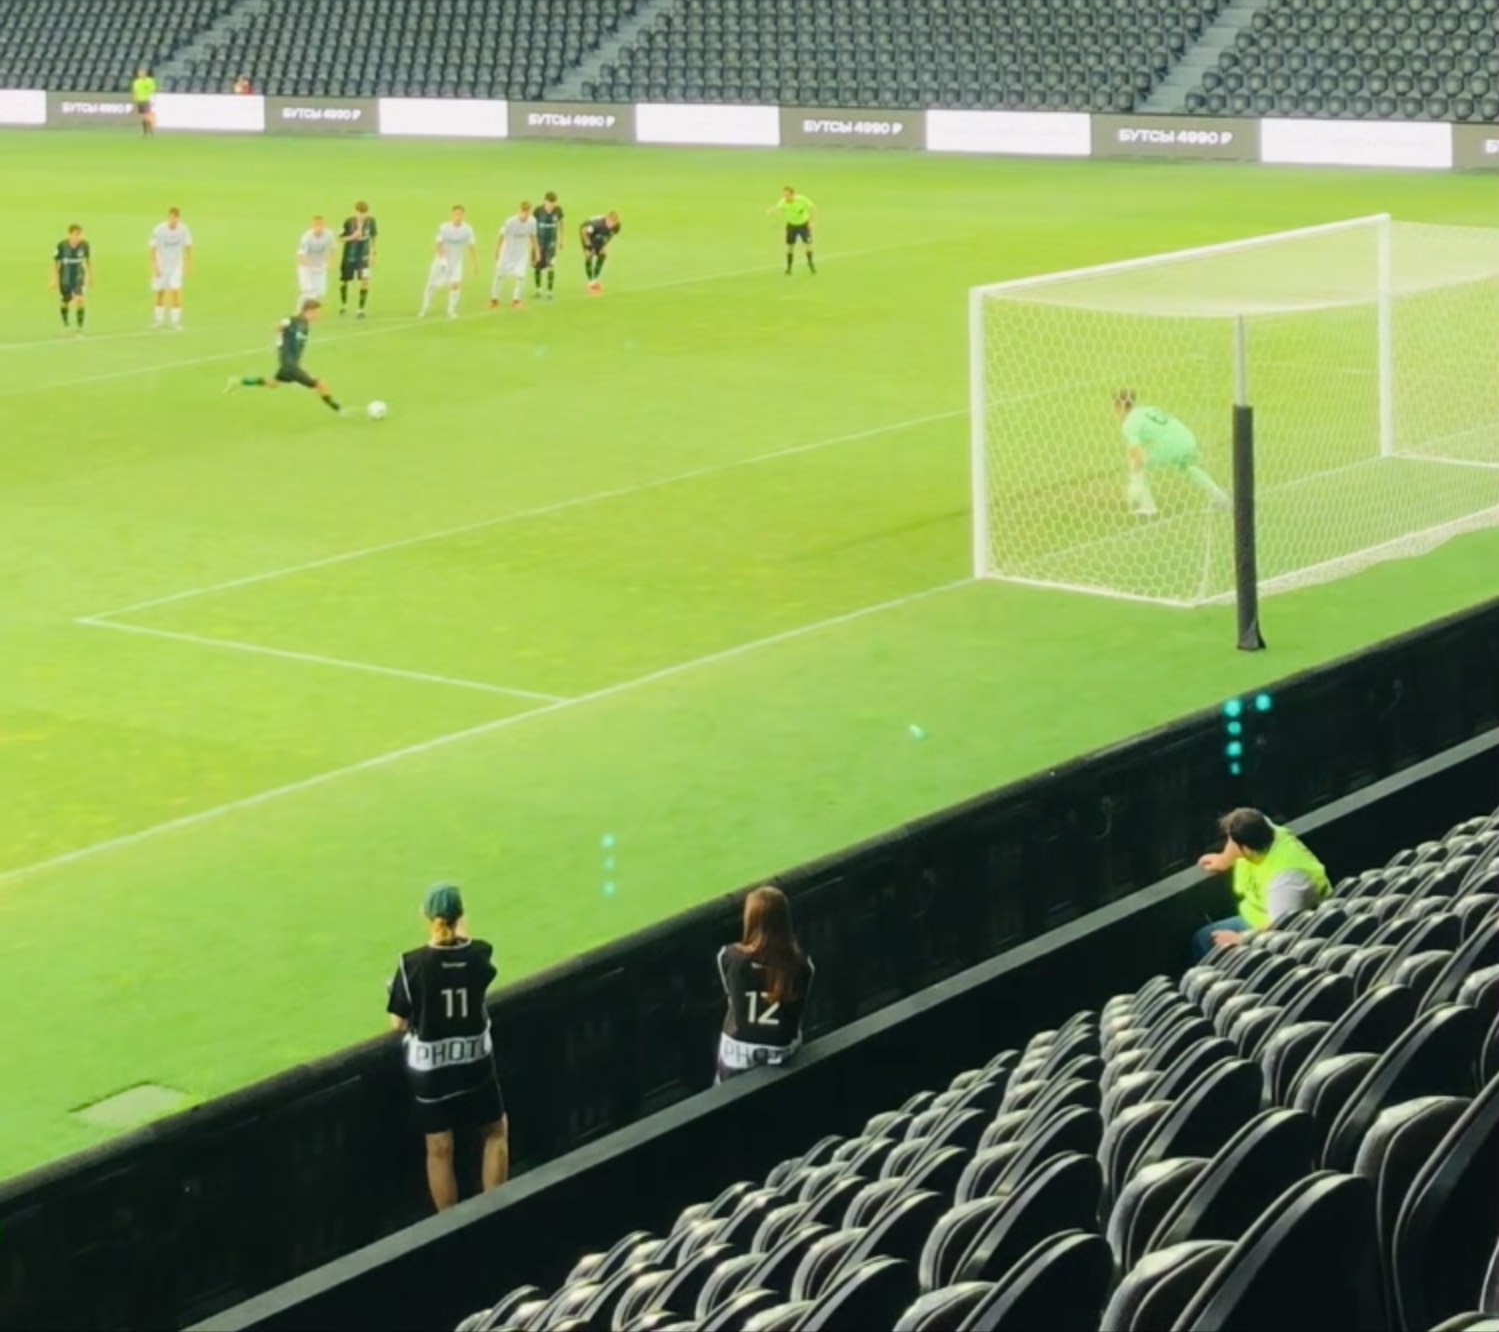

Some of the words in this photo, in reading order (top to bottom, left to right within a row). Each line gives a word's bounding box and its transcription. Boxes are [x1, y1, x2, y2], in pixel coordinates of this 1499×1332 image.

[803, 120, 853, 133] БУТСЫ
[854, 121, 891, 135] 4990
[1118, 128, 1175, 143] БУТСЫ
[1177, 130, 1219, 144] 4990
[441, 988, 468, 1018] 11
[744, 991, 780, 1025] 12
